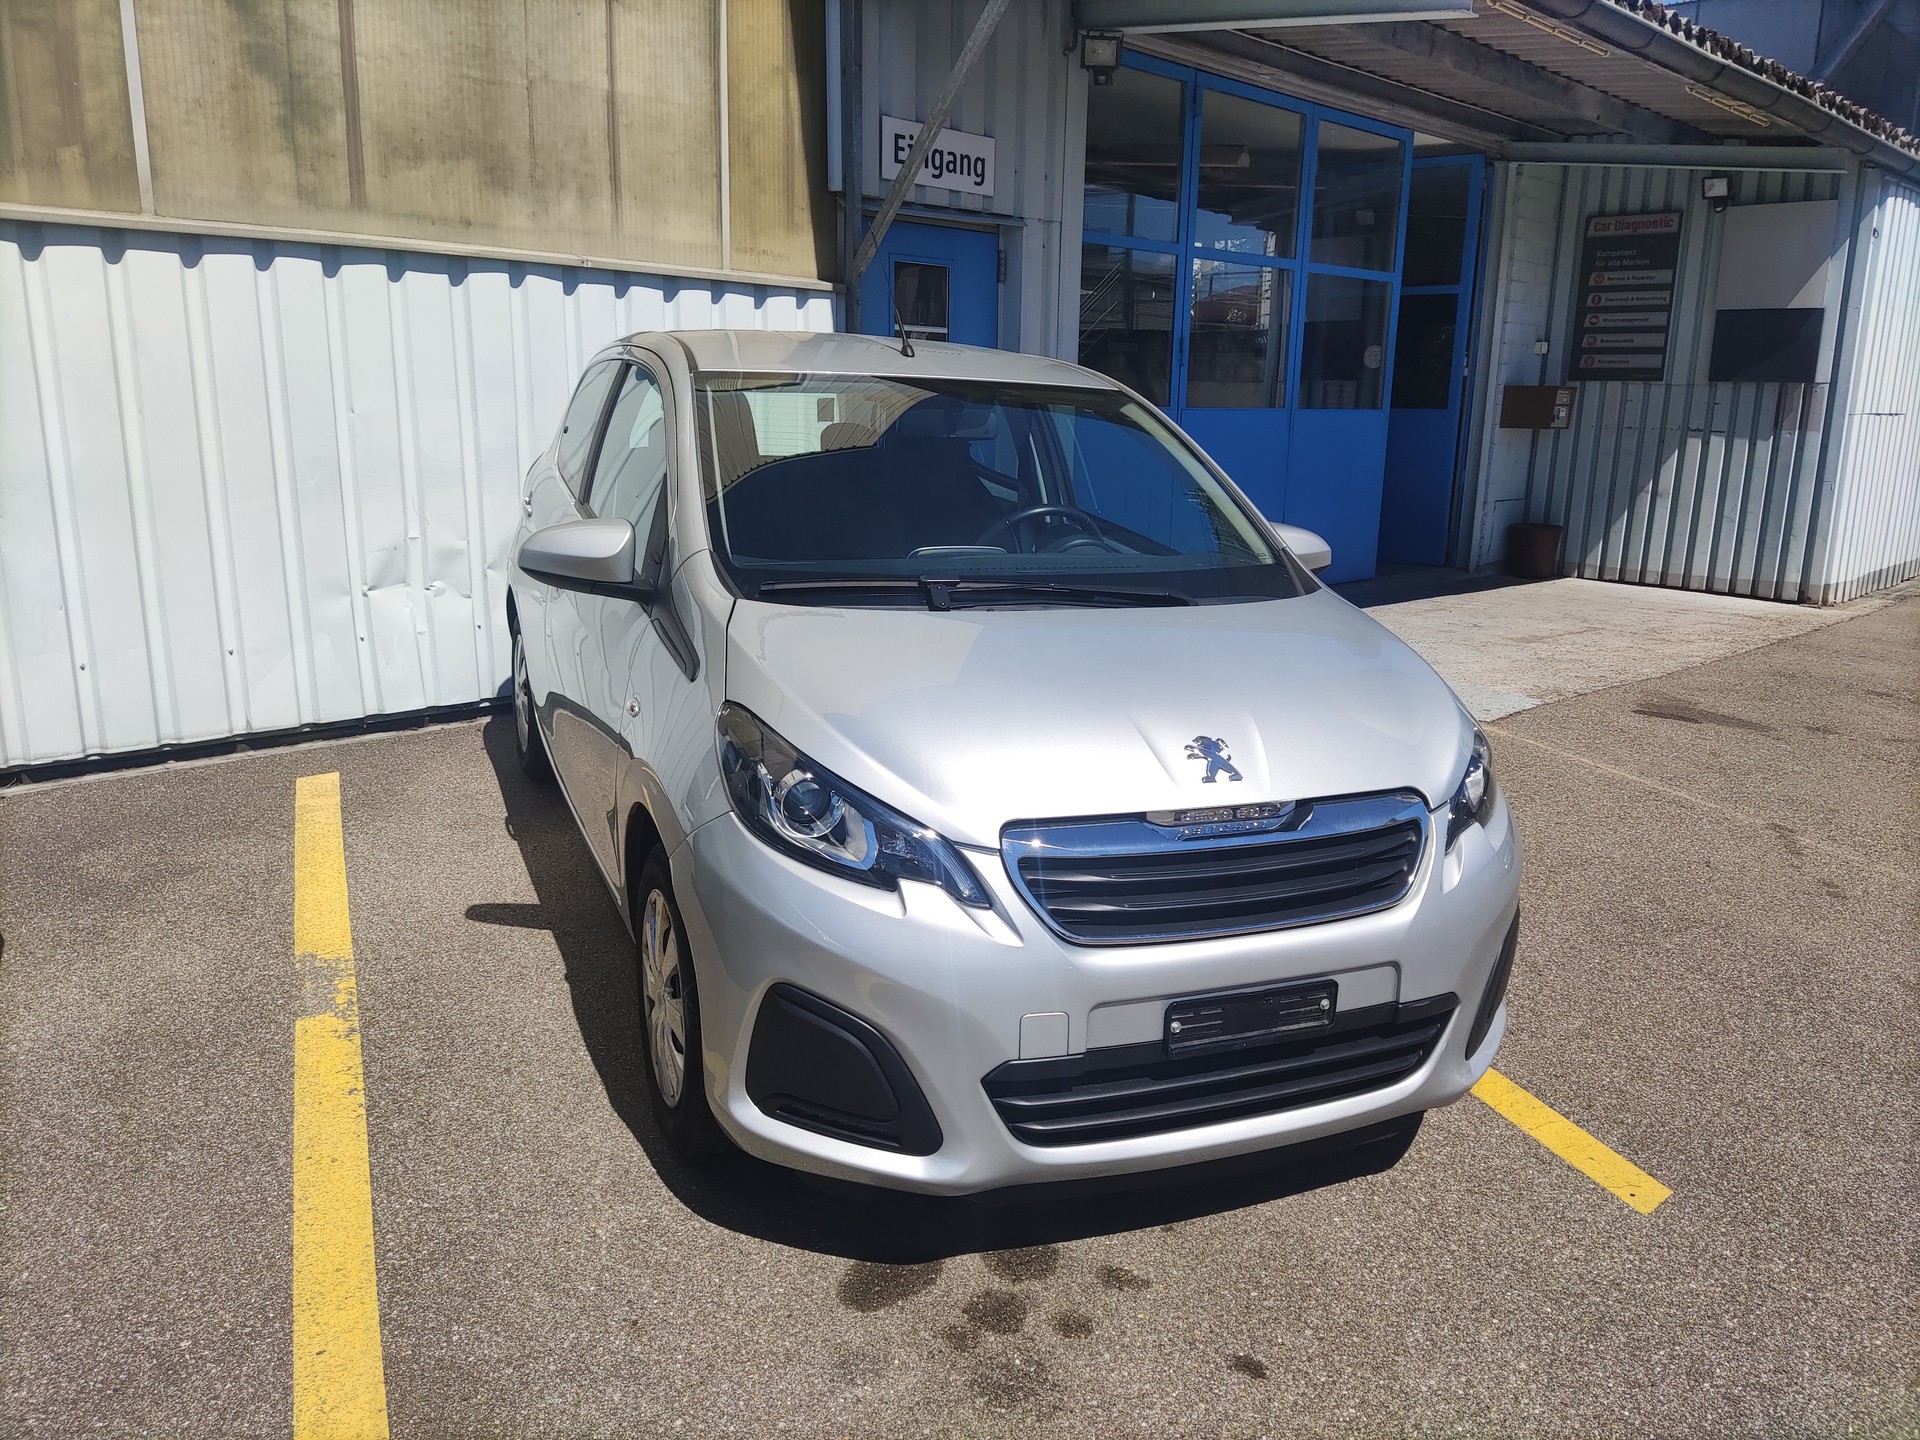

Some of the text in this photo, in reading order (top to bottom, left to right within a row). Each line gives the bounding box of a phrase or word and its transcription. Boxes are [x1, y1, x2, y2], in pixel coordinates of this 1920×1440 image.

[894, 132, 986, 187] Eigang
[1594, 216, 1674, 233] Car Diagnostic
[1596, 249, 1637, 258] Kompetenz
[1595, 258, 1650, 267] für alle Marken
